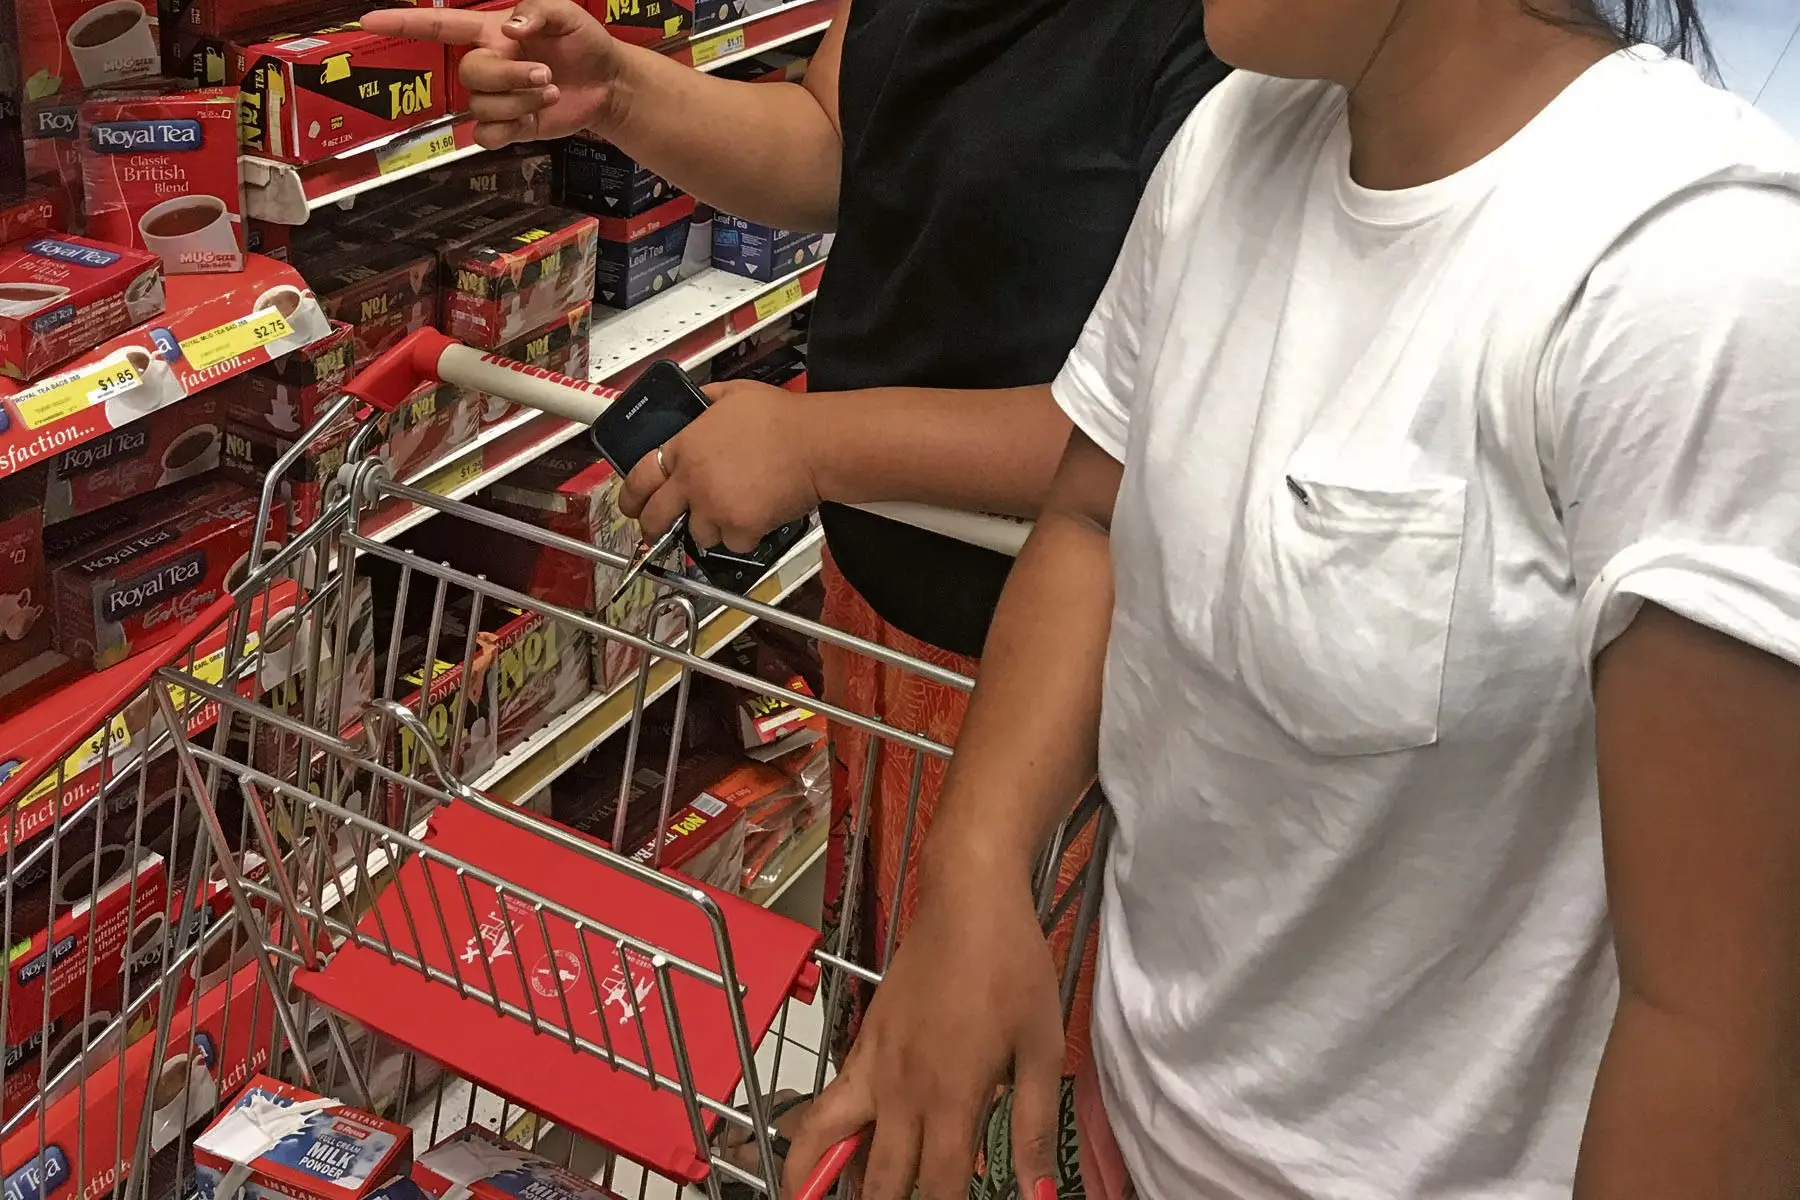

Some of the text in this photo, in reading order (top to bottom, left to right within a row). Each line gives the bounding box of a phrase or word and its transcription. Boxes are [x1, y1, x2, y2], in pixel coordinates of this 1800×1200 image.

[646, 2, 661, 18] TEA
[103, 56, 135, 73] MUG
[38, 111, 78, 131] Roy
[98, 125, 196, 148] Royal Tea
[430, 136, 454, 153] $1.60
[130, 155, 170, 166] Classic
[124, 164, 186, 182] British
[154, 181, 190, 194] Blend
[713, 212, 748, 229] Leaf Tea
[80, 249, 112, 266] Tea
[180, 252, 215, 264] MUG
[629, 246, 664, 268] Leaf Tea
[253, 319, 286, 340] $2.75
[98, 369, 135, 392] $1.85
[36, 386, 51, 396] TEA
[625, 395, 649, 421] SAMSUNG
[64, 432, 146, 473] Royal Tea
[109, 560, 200, 612] Royal Tea
[338, 1108, 385, 1129] INSTANT
[319, 1134, 362, 1154] FULL CREAM
[306, 1141, 356, 1170] MILK
[299, 1156, 344, 1180] POWDER
